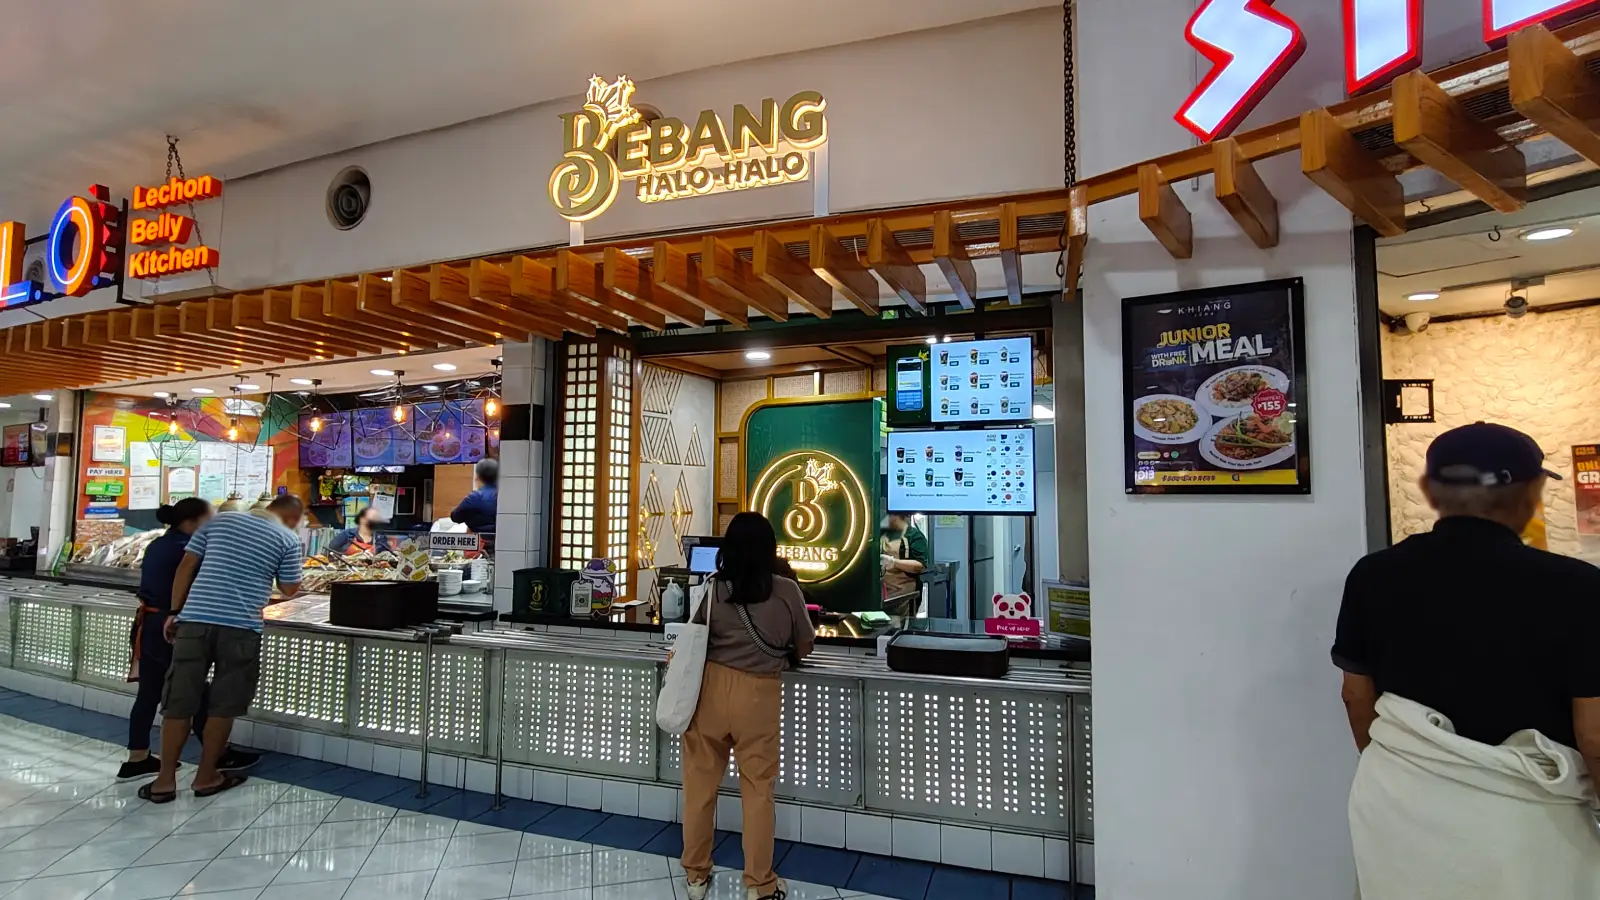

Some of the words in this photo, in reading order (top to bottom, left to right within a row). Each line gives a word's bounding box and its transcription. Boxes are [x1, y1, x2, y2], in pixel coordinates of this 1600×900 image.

[133, 175, 213, 211] Lechon
[635, 151, 809, 203] HALO-HALO
[131, 213, 184, 245] Belly
[129, 246, 210, 278] Kitchen
[1157, 323, 1231, 348] JUNIOR
[1190, 334, 1273, 366] MEAL
[1151, 352, 1169, 361] WITH
[432, 536, 456, 546] ORDER
[457, 537, 476, 547] HERE
